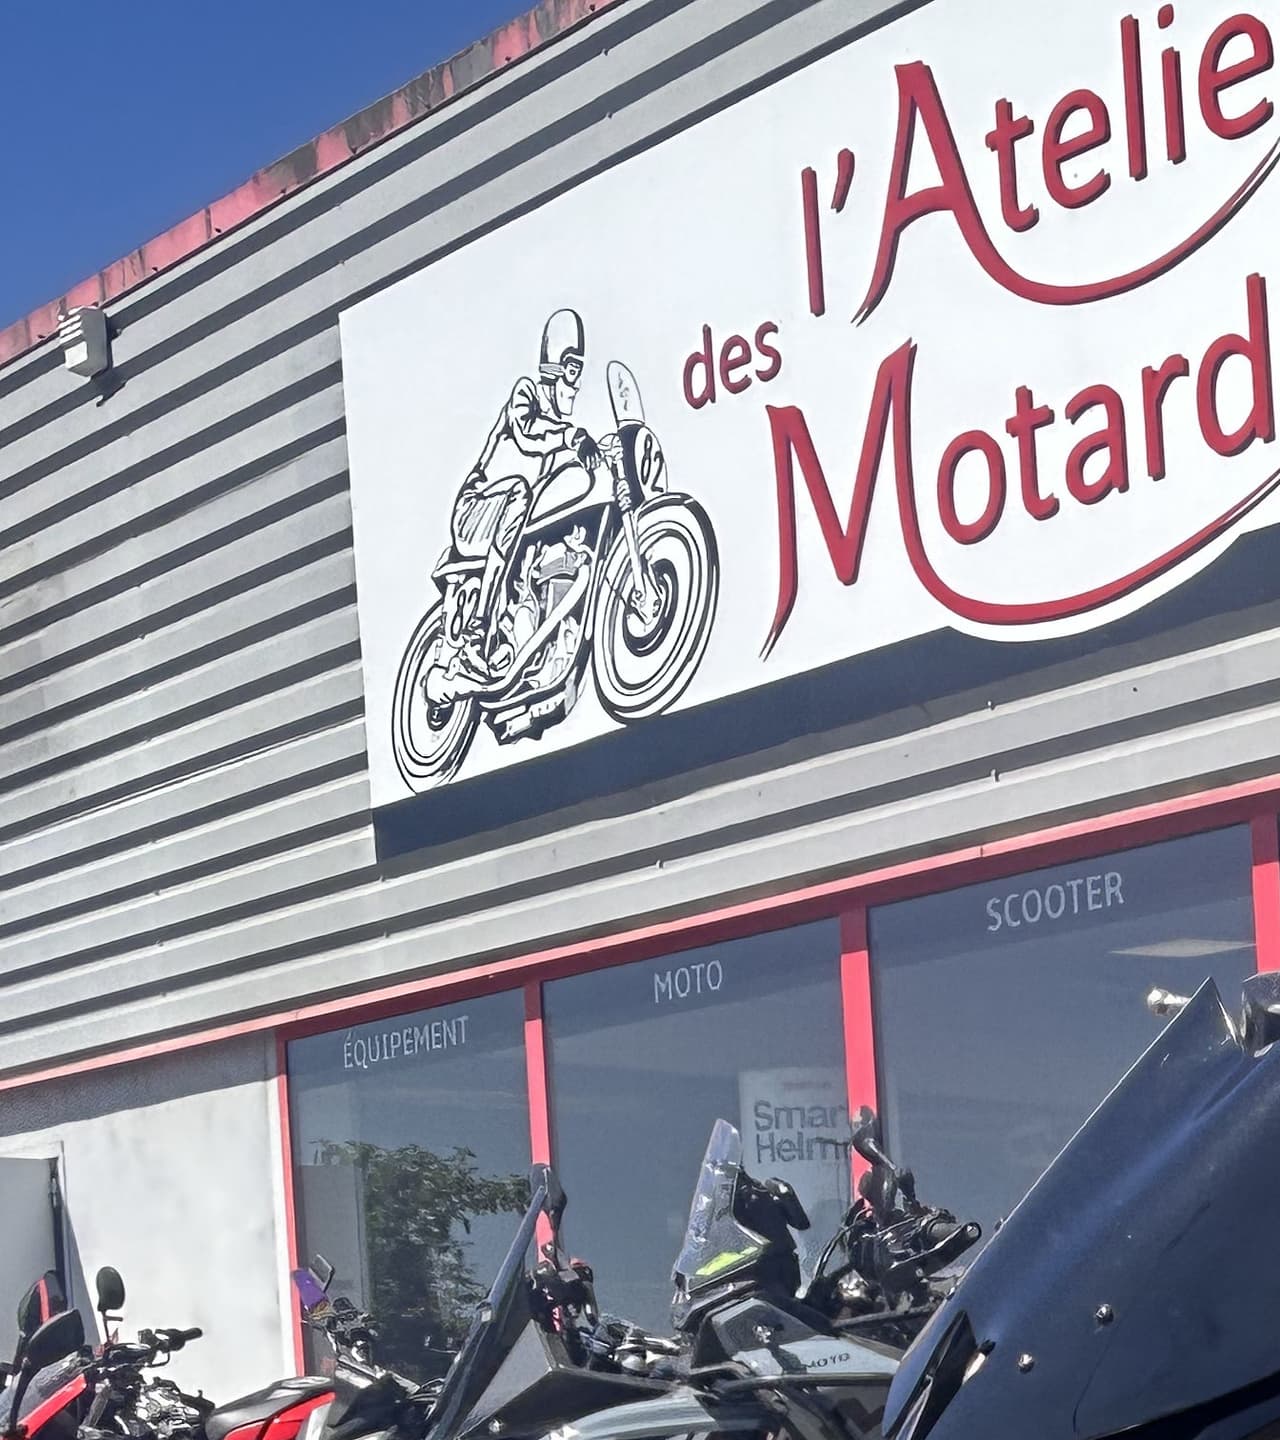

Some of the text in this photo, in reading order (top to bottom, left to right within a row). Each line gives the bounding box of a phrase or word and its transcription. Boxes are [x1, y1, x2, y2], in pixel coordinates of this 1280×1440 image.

[684, 316, 783, 410] des
[641, 433, 664, 492] 82
[986, 871, 1125, 932] SCOOTER
[654, 959, 723, 1004] MOTO
[343, 1015, 469, 1069] ÉQUIPEMENT
[754, 1099, 848, 1132] Smar
